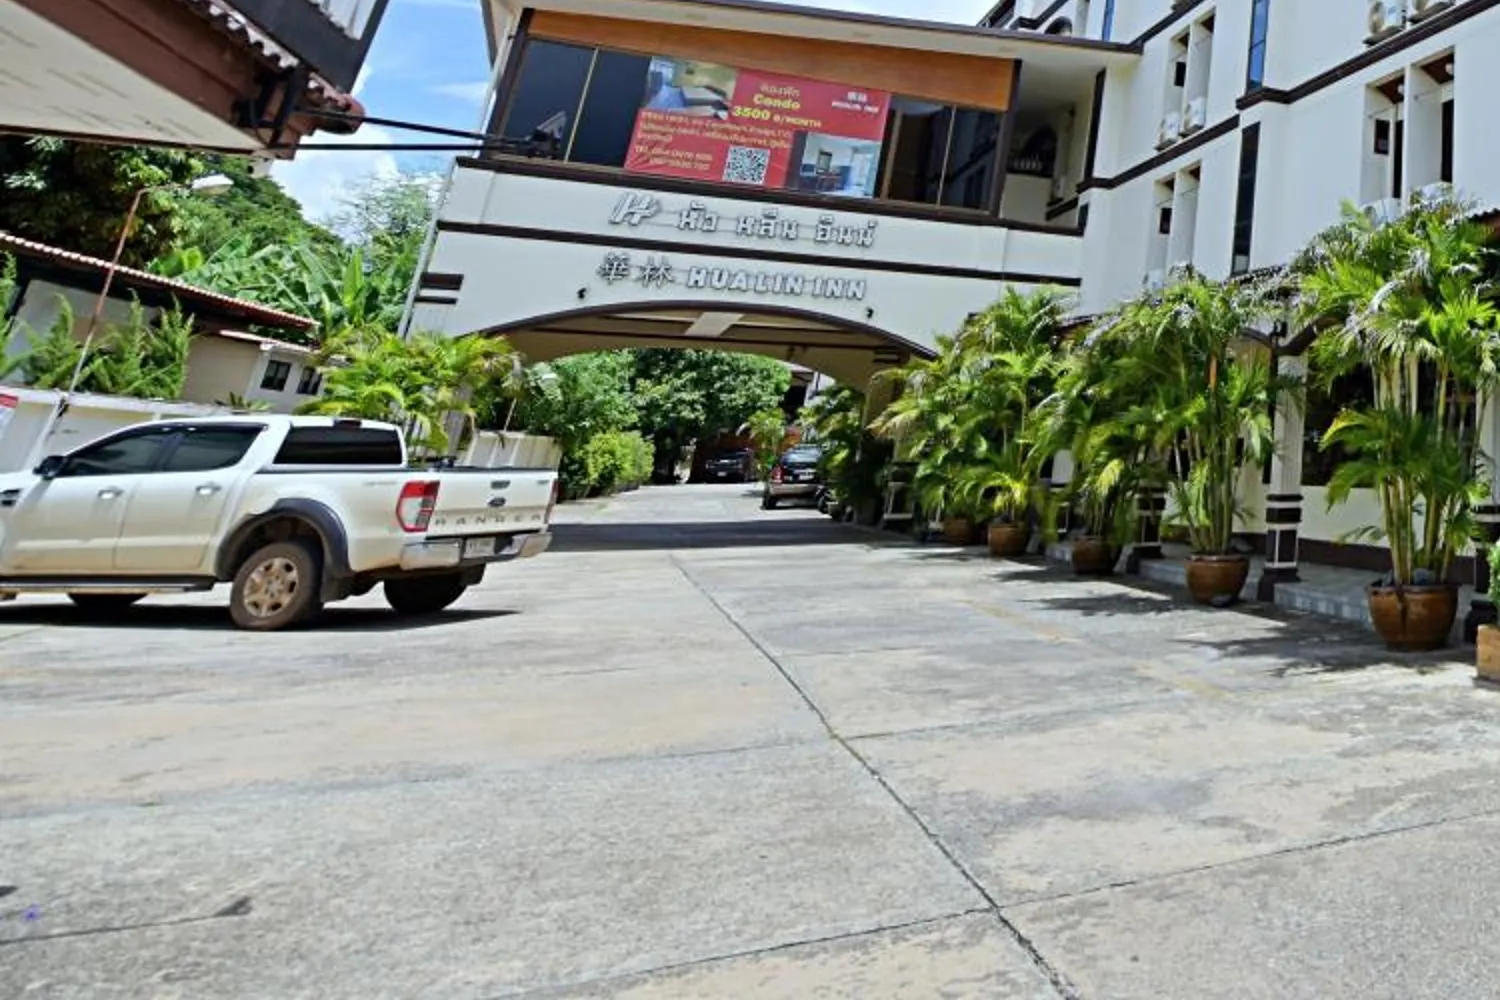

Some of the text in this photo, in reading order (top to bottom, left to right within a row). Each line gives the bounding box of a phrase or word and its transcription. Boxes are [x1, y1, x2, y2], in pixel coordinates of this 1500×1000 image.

[732, 105, 770, 121] 3500
[753, 93, 800, 110] Condo
[678, 200, 719, 232] หัว
[687, 265, 867, 301] HUALIN INN
